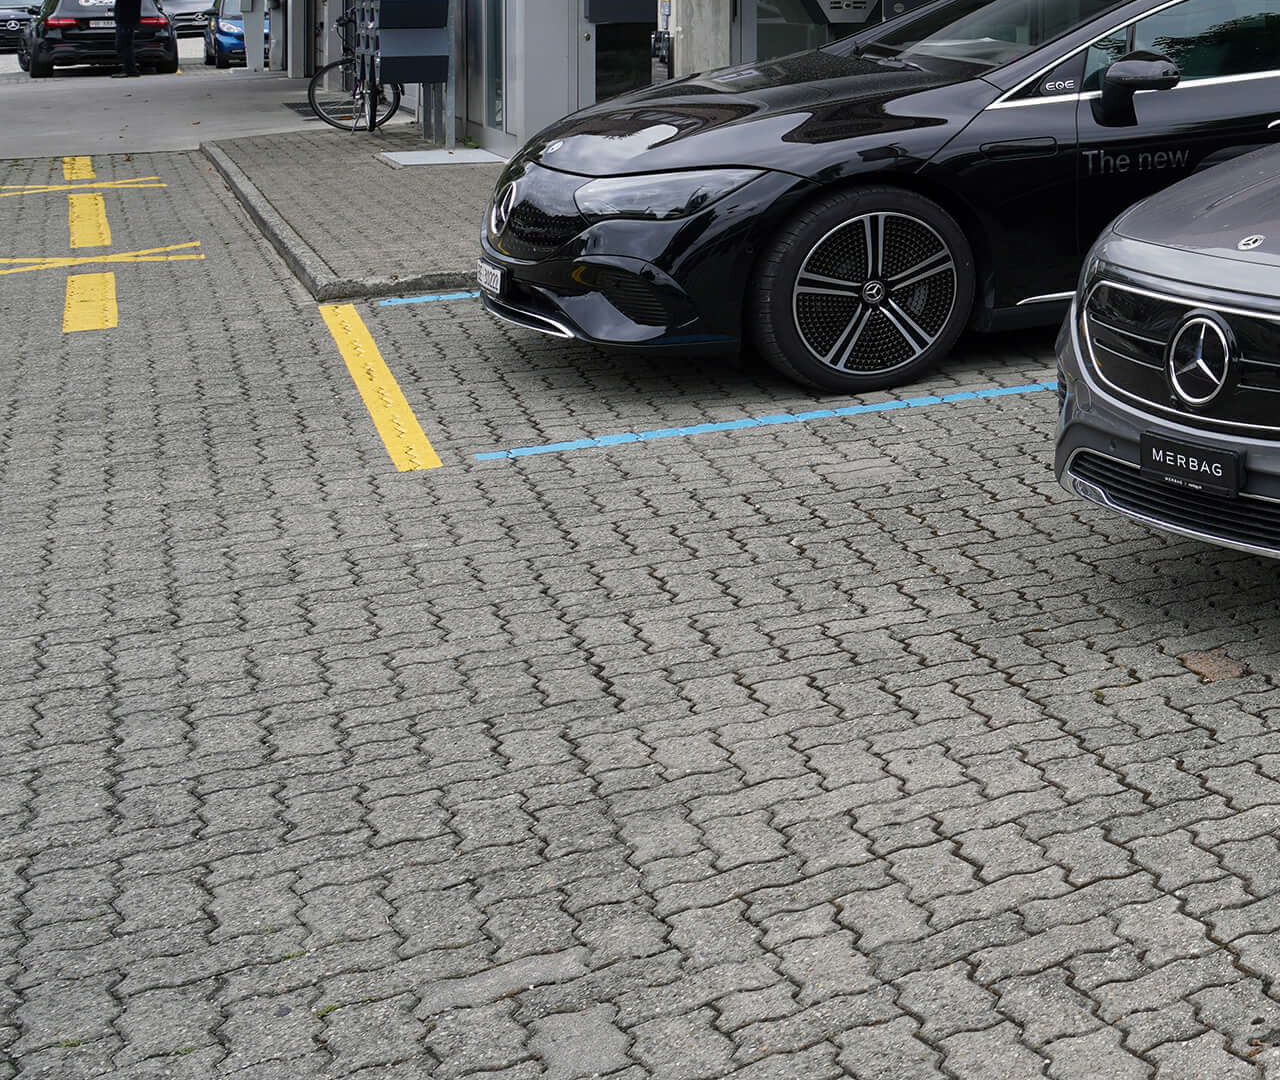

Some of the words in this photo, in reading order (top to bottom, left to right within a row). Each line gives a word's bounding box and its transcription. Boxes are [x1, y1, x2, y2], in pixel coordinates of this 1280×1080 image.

[1045, 79, 1075, 91] EQE
[1082, 149, 1130, 177] The
[1138, 150, 1190, 171] new
[1151, 447, 1223, 477] MERBAG
